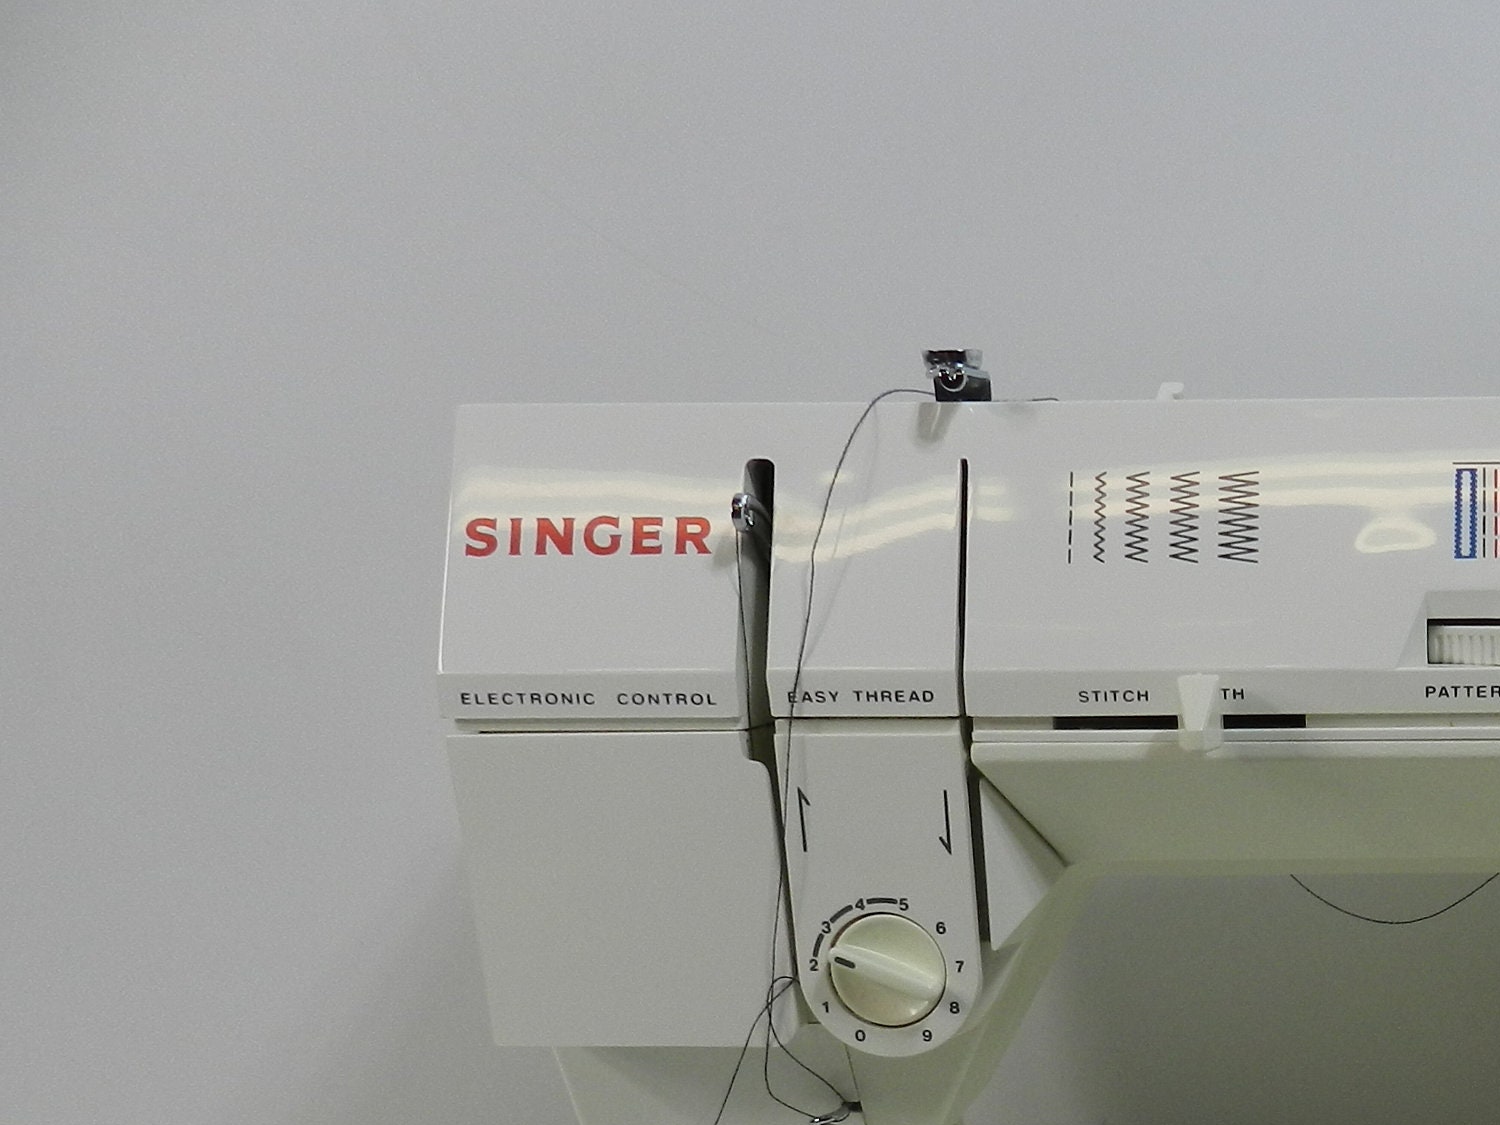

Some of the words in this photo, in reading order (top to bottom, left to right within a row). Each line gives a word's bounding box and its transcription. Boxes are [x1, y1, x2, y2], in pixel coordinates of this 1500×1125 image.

[464, 515, 712, 558] SINGER
[460, 691, 596, 706] ELECTRONIC
[616, 691, 718, 706] CONTROL
[787, 689, 839, 704] EASY
[853, 688, 935, 703] THREAD
[1077, 689, 1150, 703] STITCH
[854, 898, 866, 911] 4
[899, 897, 909, 911] 5
[821, 920, 832, 934] 3
[935, 921, 947, 935] 6
[809, 959, 819, 971] 2
[955, 960, 965, 973] 7
[821, 1001, 830, 1013] 1
[949, 1001, 961, 1014] 8
[855, 1029, 866, 1042] 0
[922, 1029, 933, 1042] 9
